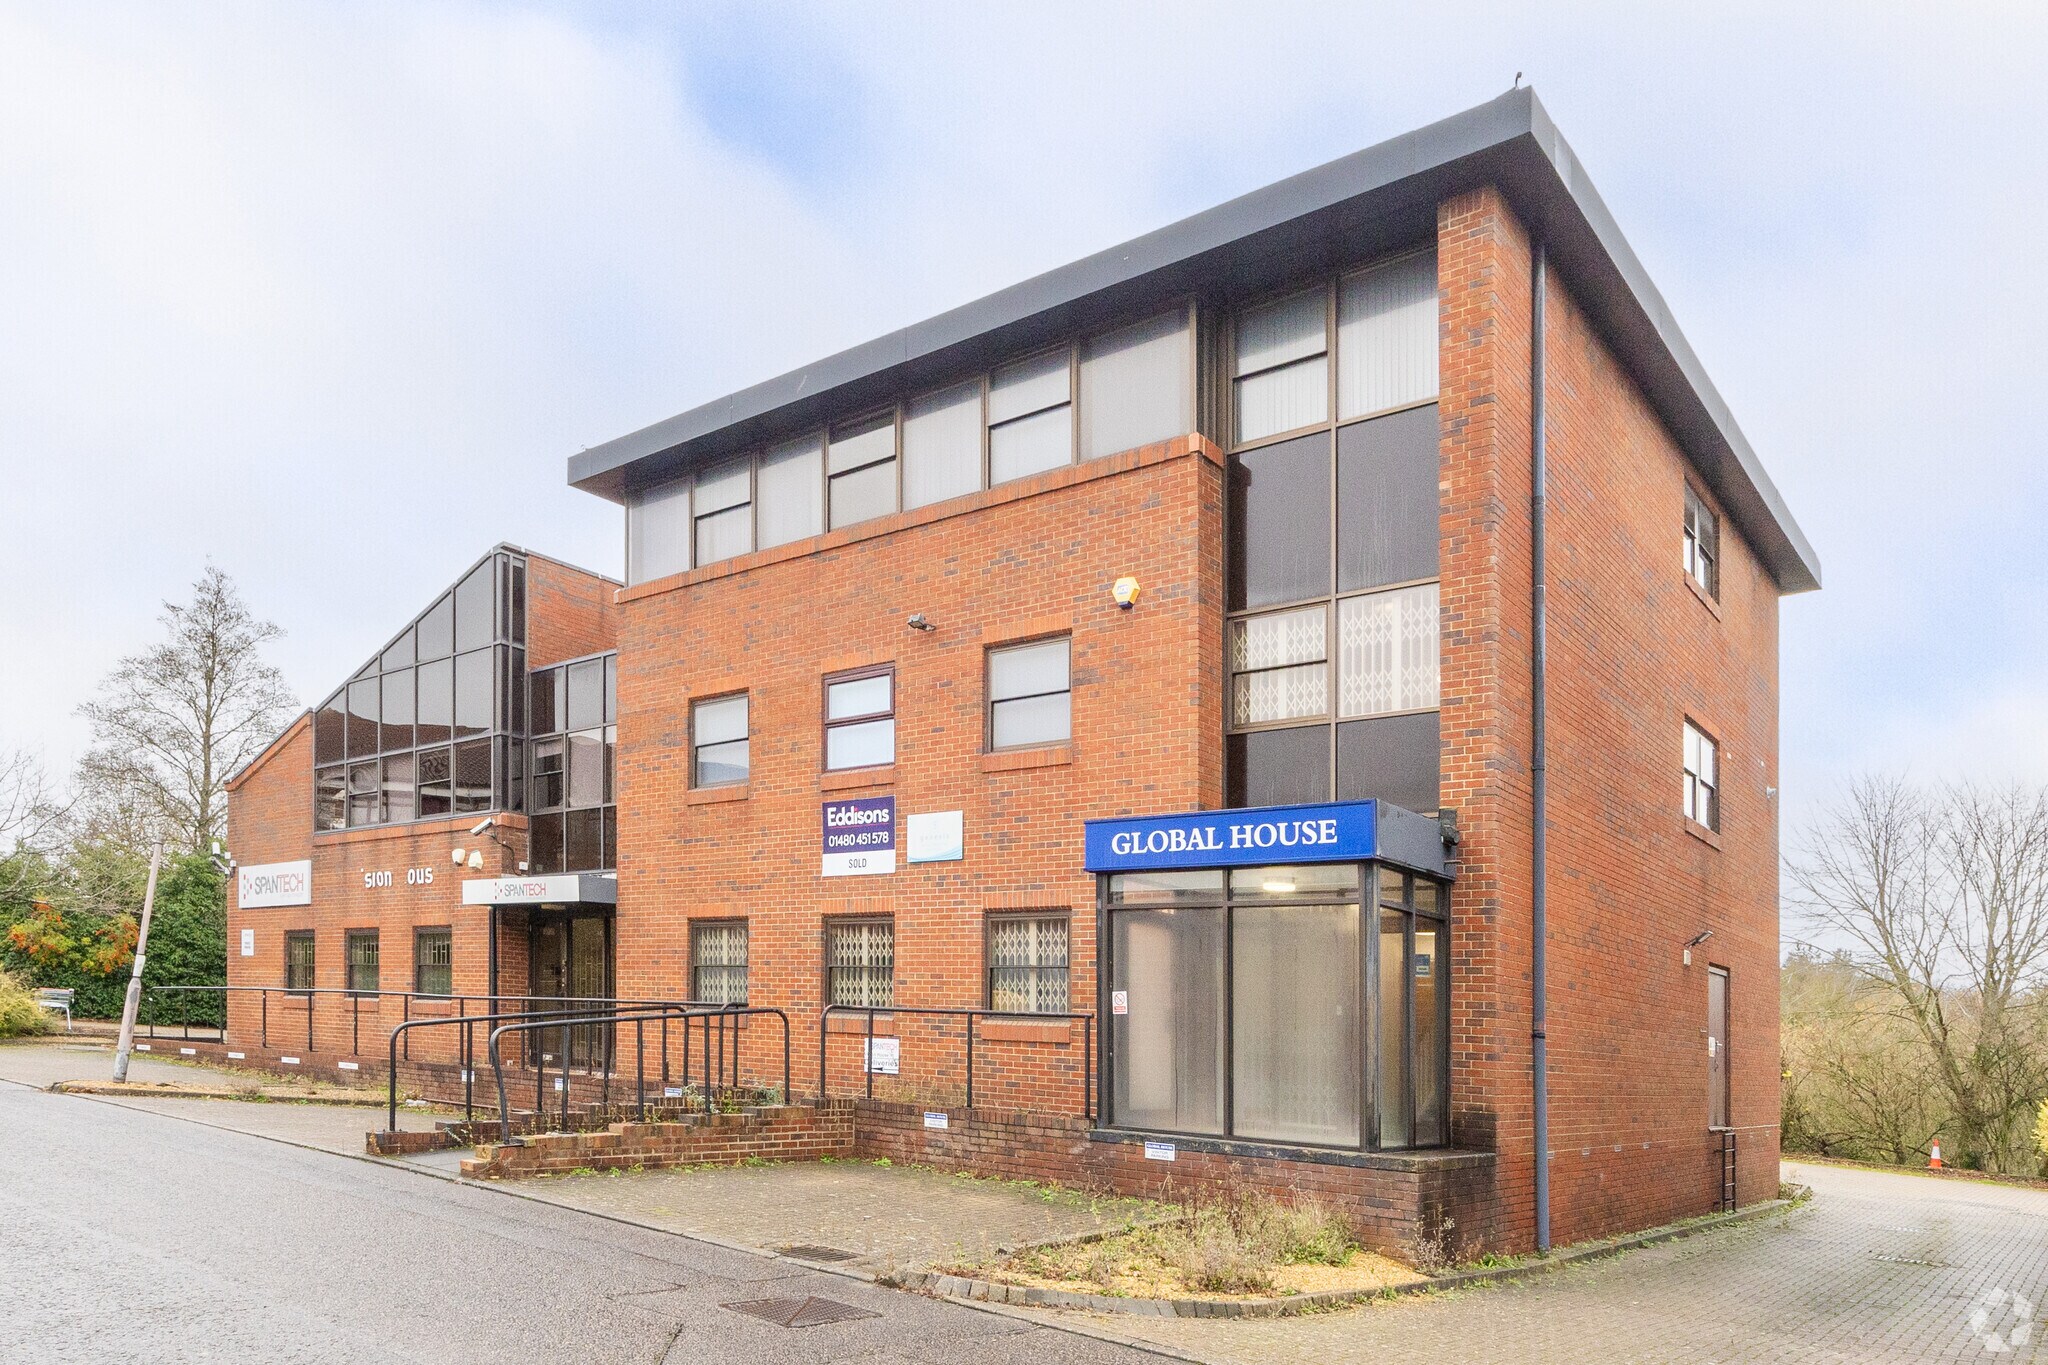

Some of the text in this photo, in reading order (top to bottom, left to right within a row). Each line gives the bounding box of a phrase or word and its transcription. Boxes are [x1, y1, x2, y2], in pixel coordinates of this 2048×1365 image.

[827, 806, 890, 827] Eddisons
[828, 831, 889, 848] 01480 451578
[1111, 819, 1338, 855] GLOBAL HOUSE
[848, 858, 867, 869] SOLD
[254, 873, 304, 895] SPANTECH
[504, 883, 547, 897] SPANTECH
